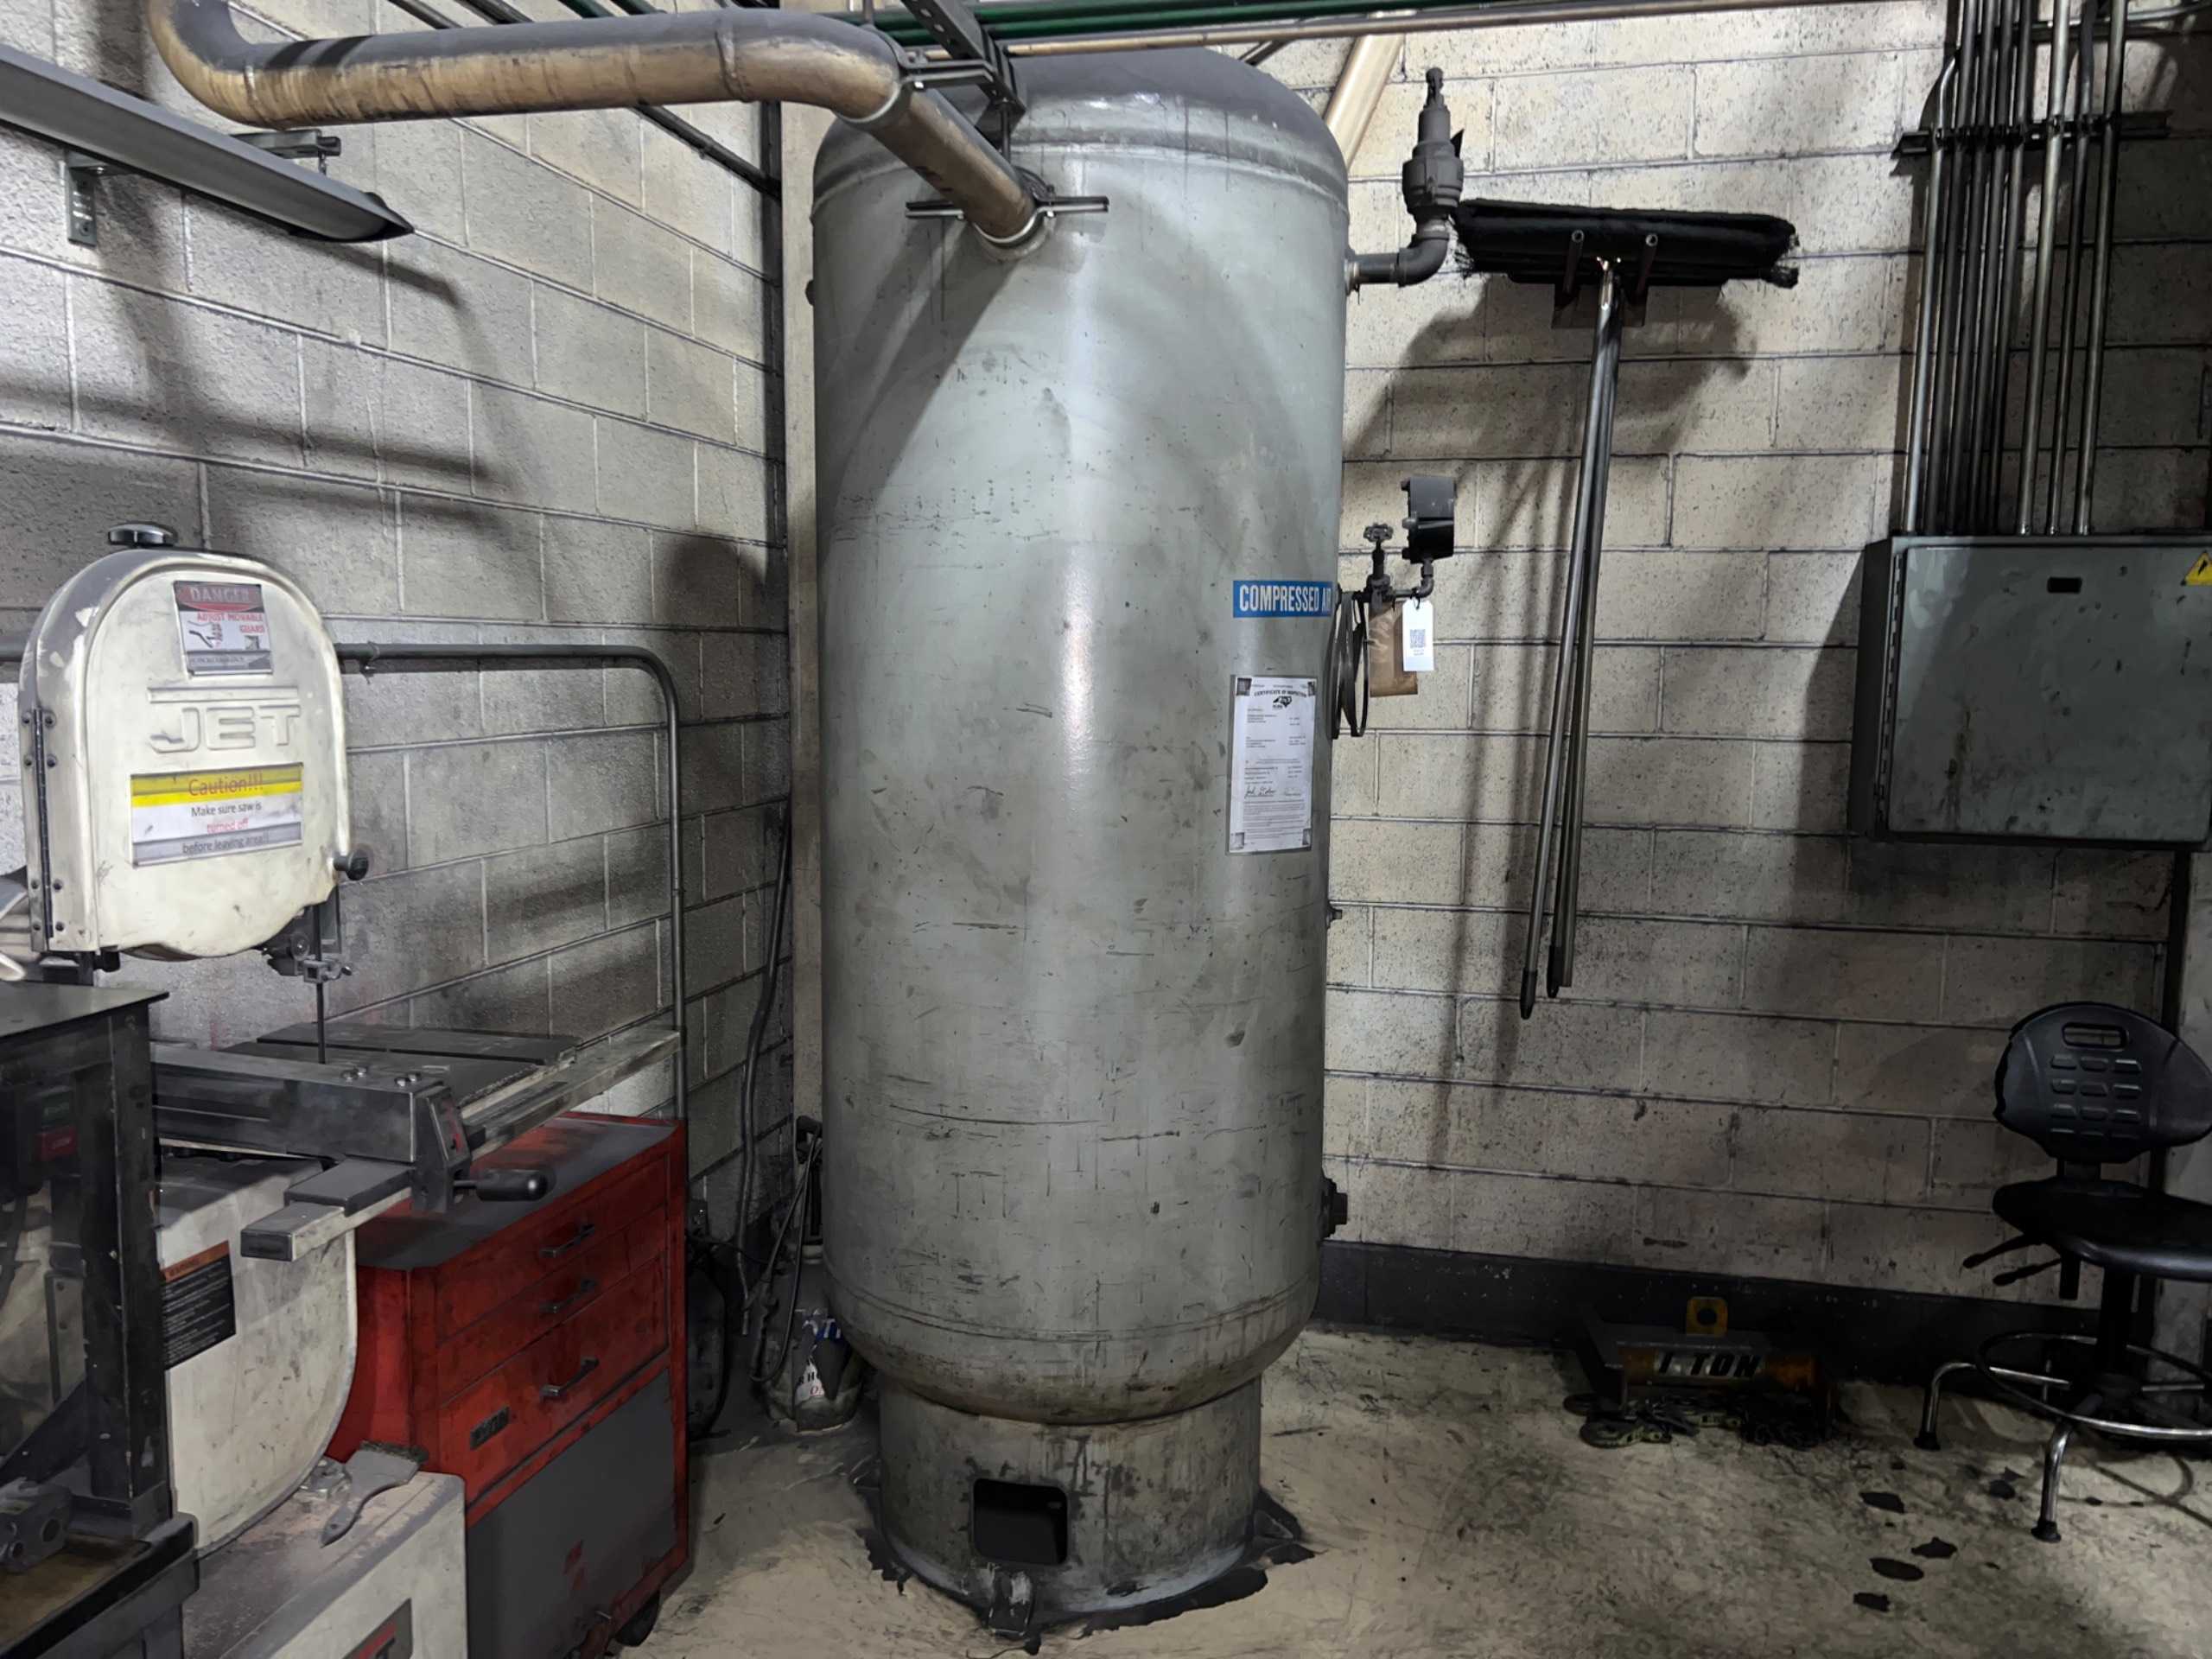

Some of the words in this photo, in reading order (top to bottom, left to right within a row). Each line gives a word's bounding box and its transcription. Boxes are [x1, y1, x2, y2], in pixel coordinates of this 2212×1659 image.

[191, 586, 250, 602] DANGER
[1239, 584, 1319, 612] COMPRESSED
[198, 613, 226, 621] ADJUST
[227, 613, 264, 622] MOVABLE
[239, 624, 265, 633] GUARD
[149, 704, 301, 753] JET
[188, 773, 263, 796] Caution!!!
[191, 805, 216, 817] Make
[218, 804, 236, 815] sure
[238, 803, 254, 812] saw
[207, 821, 235, 834] turned
[238, 817, 250, 830] off
[182, 842, 213, 855] before
[215, 836, 245, 851] leaving
[1690, 1353, 1762, 1377] TON
